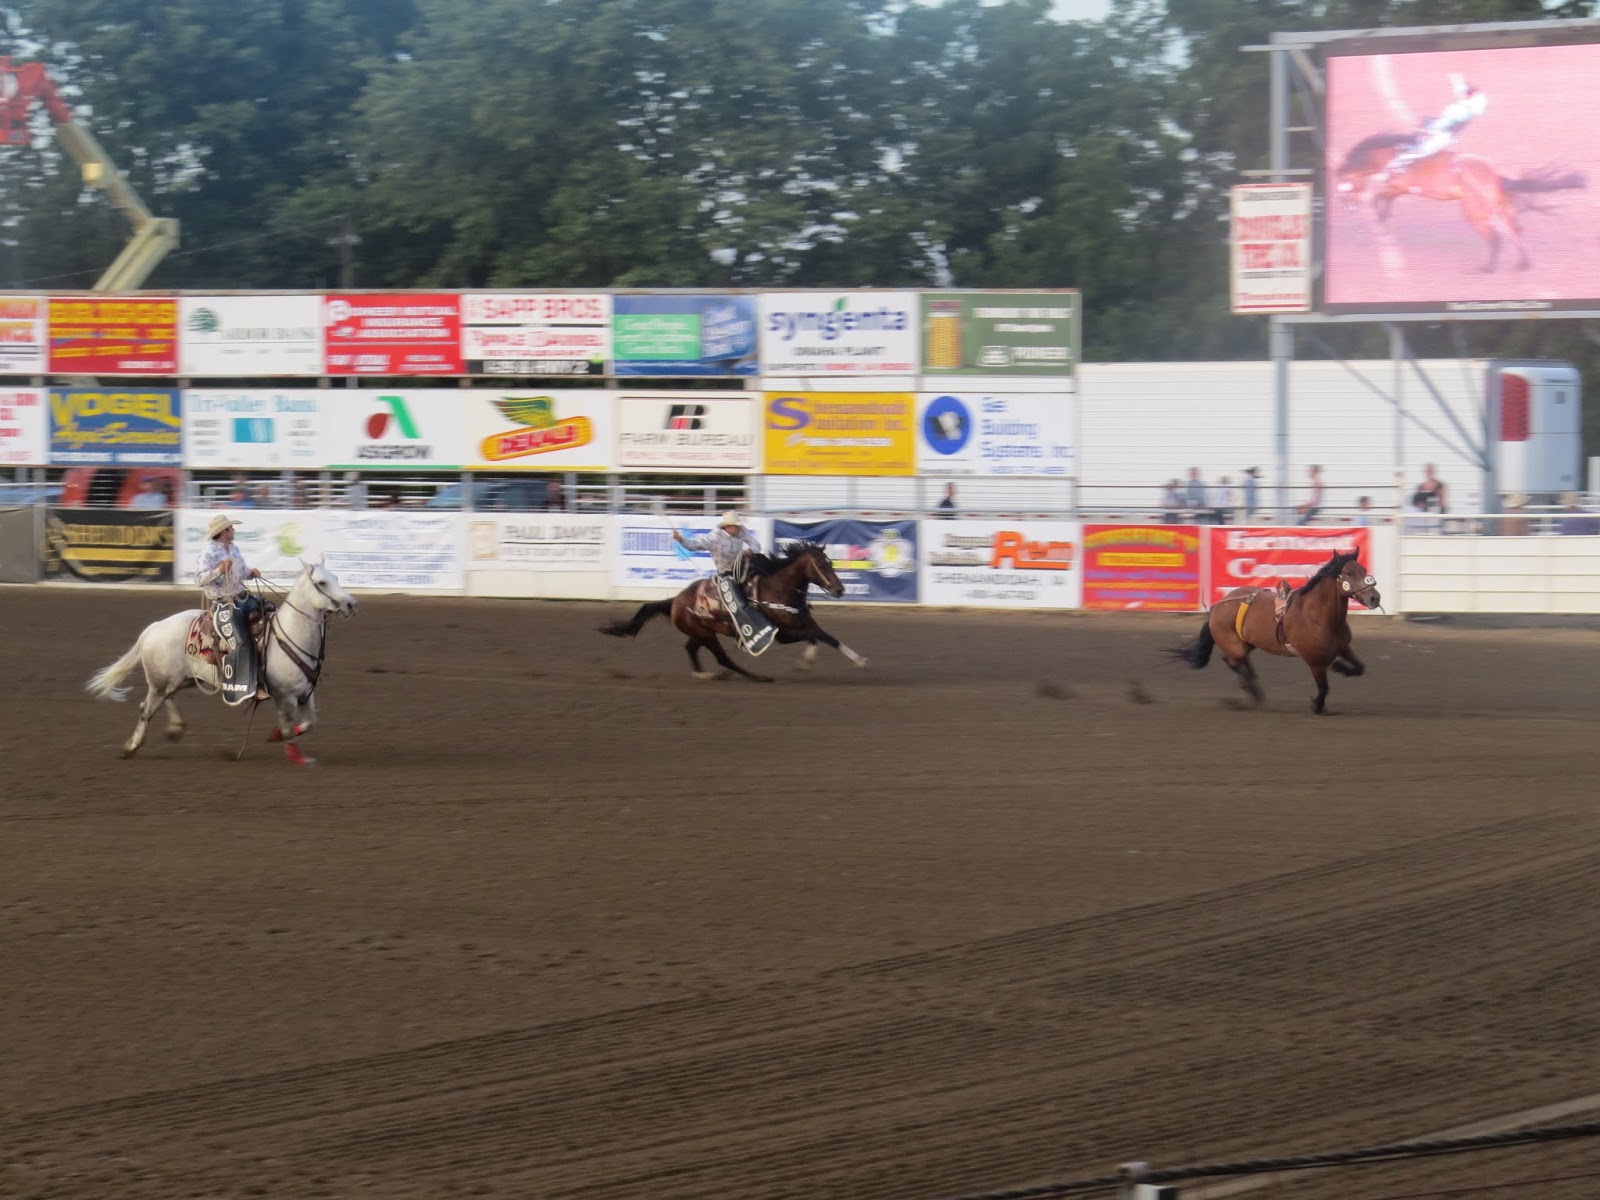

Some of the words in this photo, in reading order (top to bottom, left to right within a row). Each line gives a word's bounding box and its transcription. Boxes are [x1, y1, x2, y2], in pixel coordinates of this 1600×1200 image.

[767, 307, 908, 341] syngenta
[50, 393, 182, 428] VOGEL
[220, 682, 248, 692] RAM
